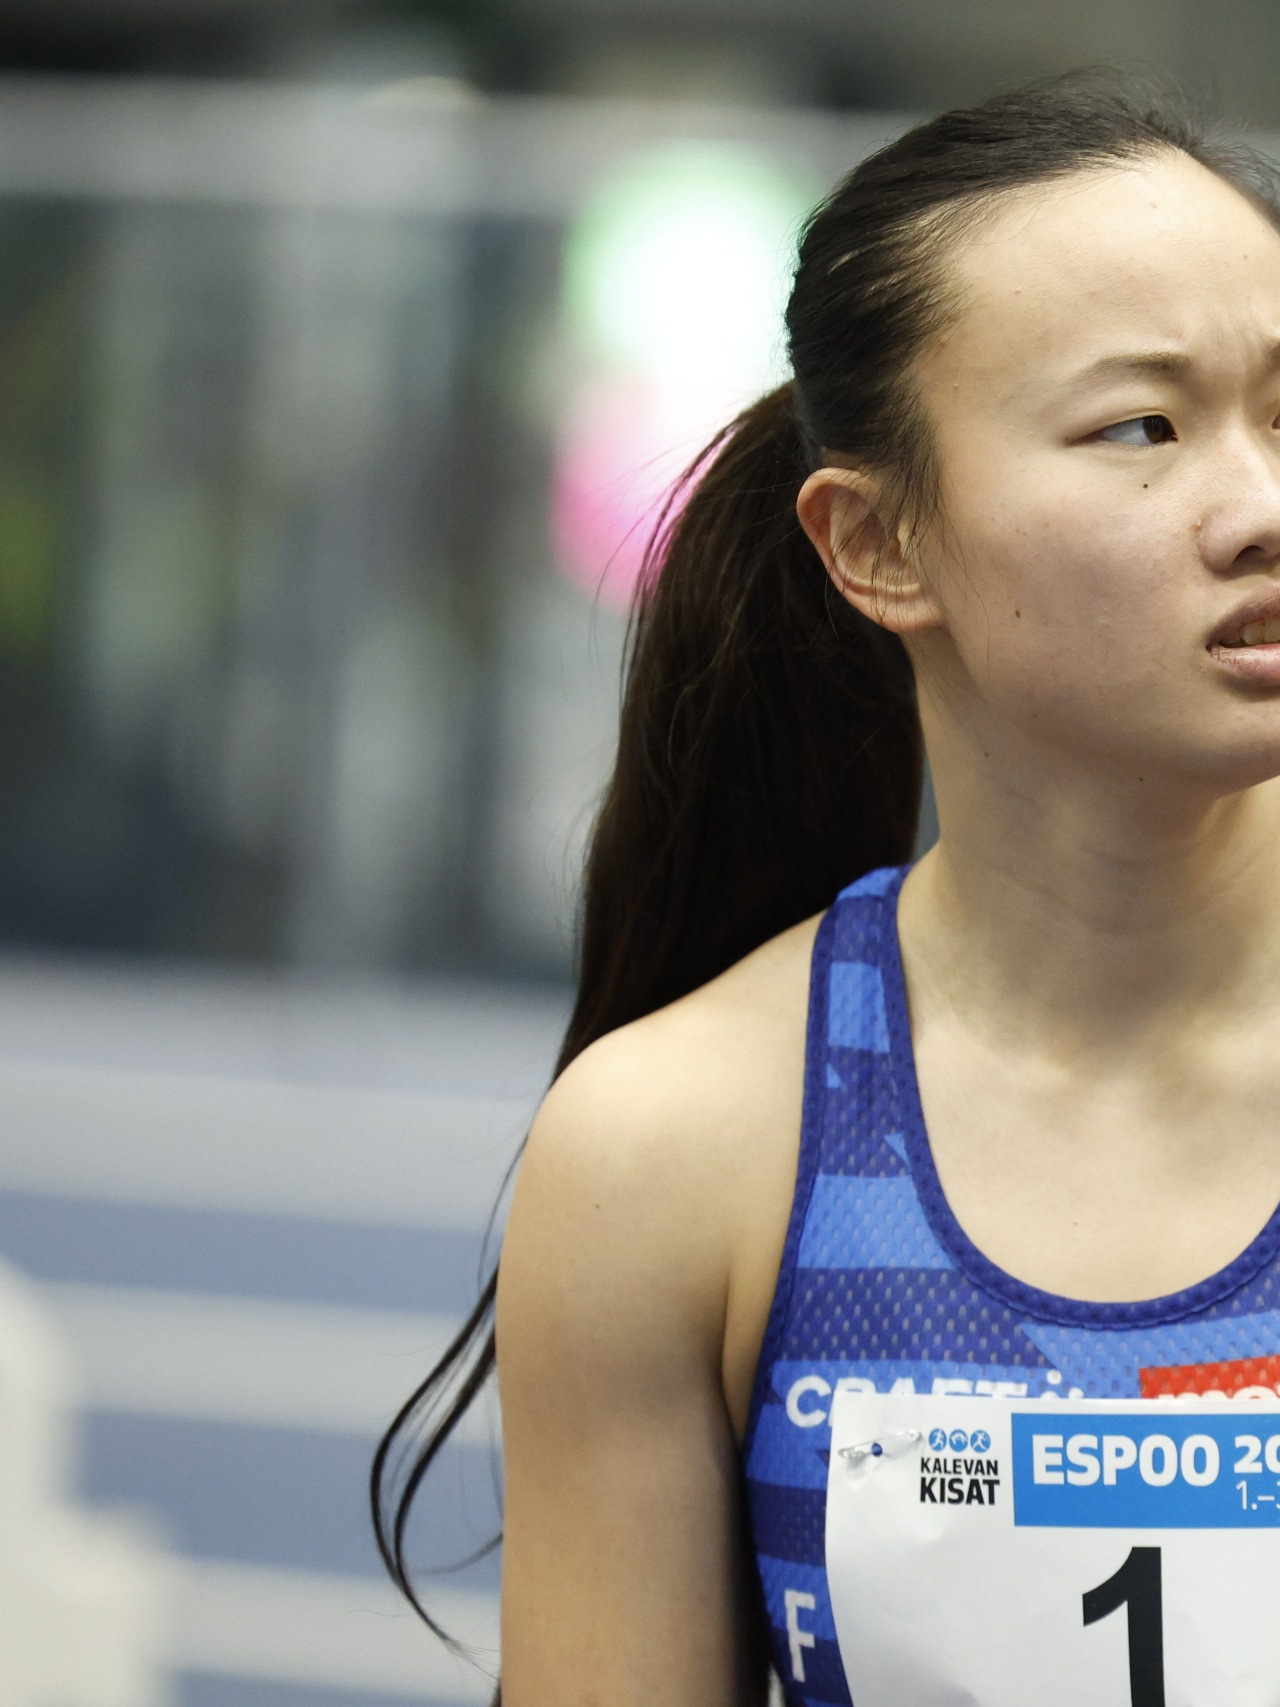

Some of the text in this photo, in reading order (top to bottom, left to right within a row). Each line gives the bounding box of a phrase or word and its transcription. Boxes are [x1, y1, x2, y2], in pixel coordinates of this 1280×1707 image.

[920, 1457, 999, 1476] KALEVAN
[1032, 1434, 1220, 1487] ESPOO
[920, 1478, 1000, 1506] KISAT
[1082, 1546, 1166, 1707] 1
